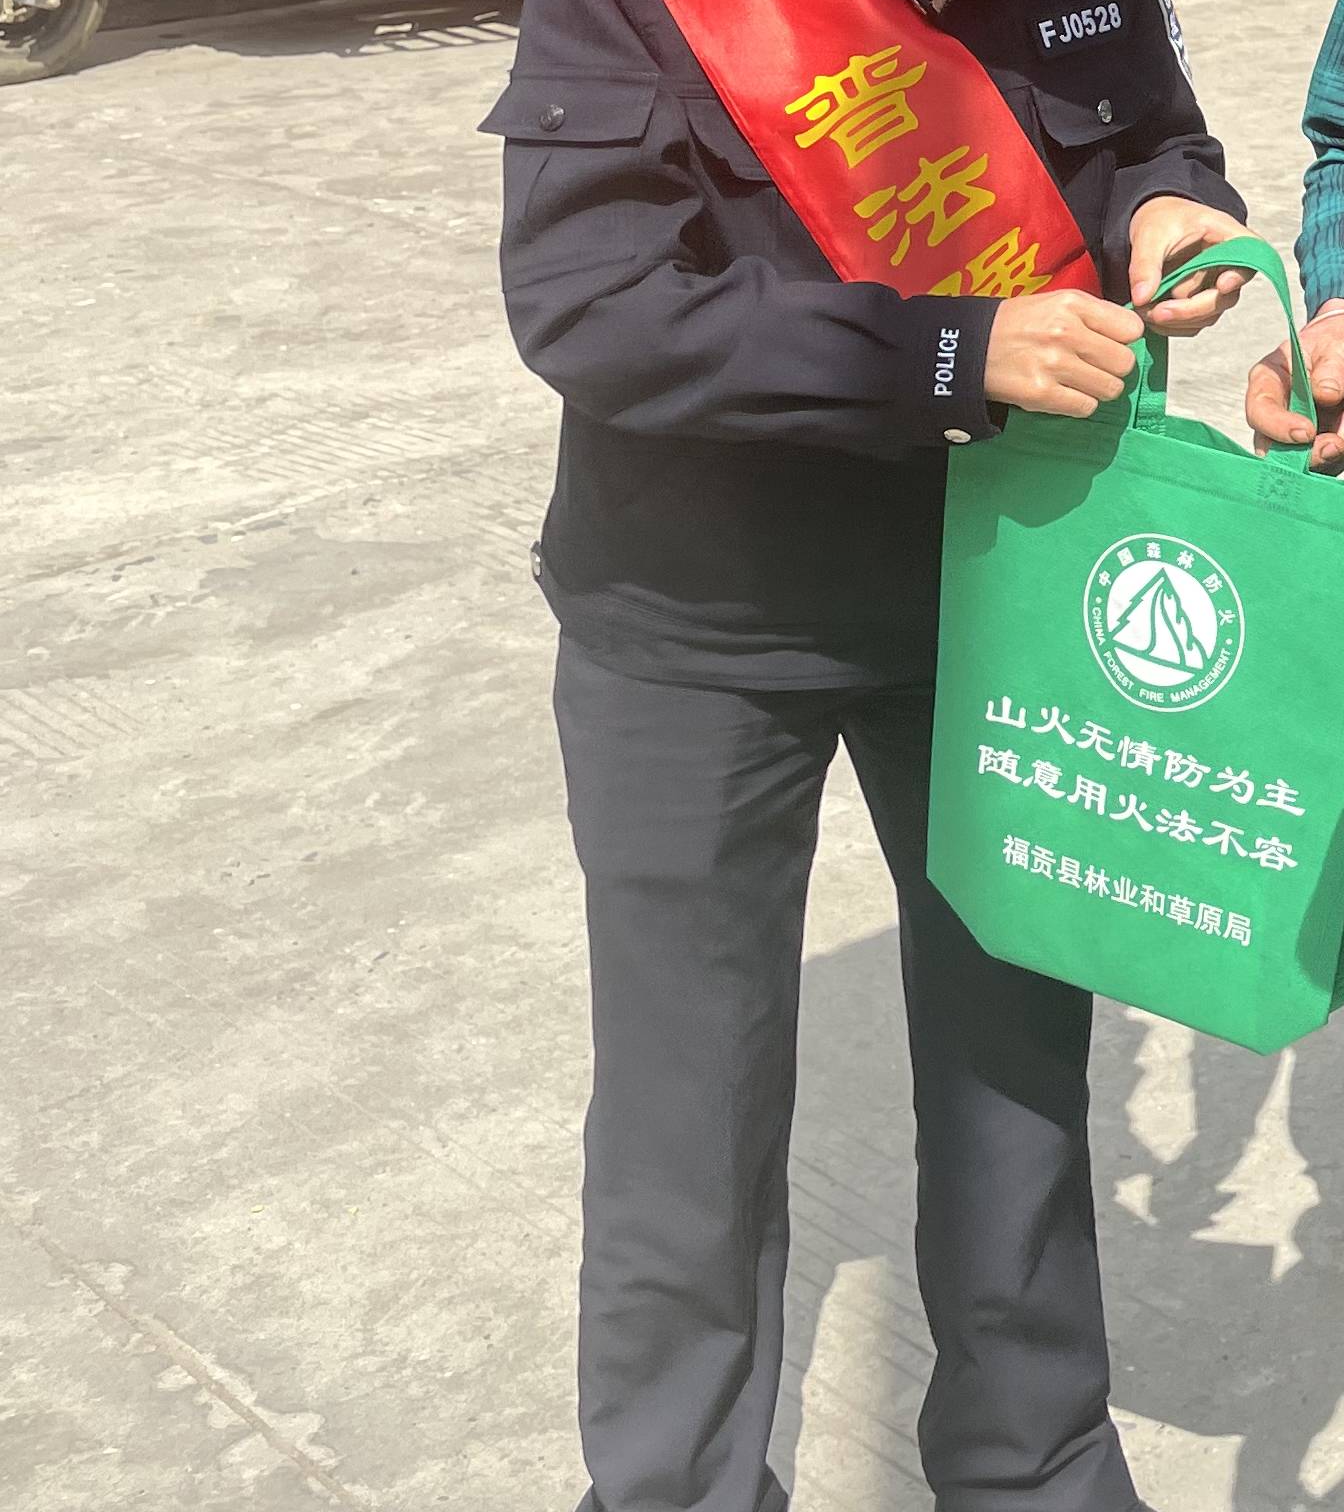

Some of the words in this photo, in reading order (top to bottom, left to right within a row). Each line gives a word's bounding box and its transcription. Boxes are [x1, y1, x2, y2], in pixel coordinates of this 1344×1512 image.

[1037, 0, 1123, 49] FJ0528
[933, 327, 961, 398] POLICE
[1098, 541, 1237, 627] 中国森林防火
[1092, 606, 1107, 647] CHINA
[1103, 650, 1135, 691] FOREST
[1138, 687, 1165, 704] FIRE
[1169, 647, 1232, 703] MANAGEMENT
[985, 695, 1307, 817] 山火无情防为主
[978, 744, 1299, 873] 随意用火法不容
[1002, 833, 1253, 948] 福贡县林业和草原局
